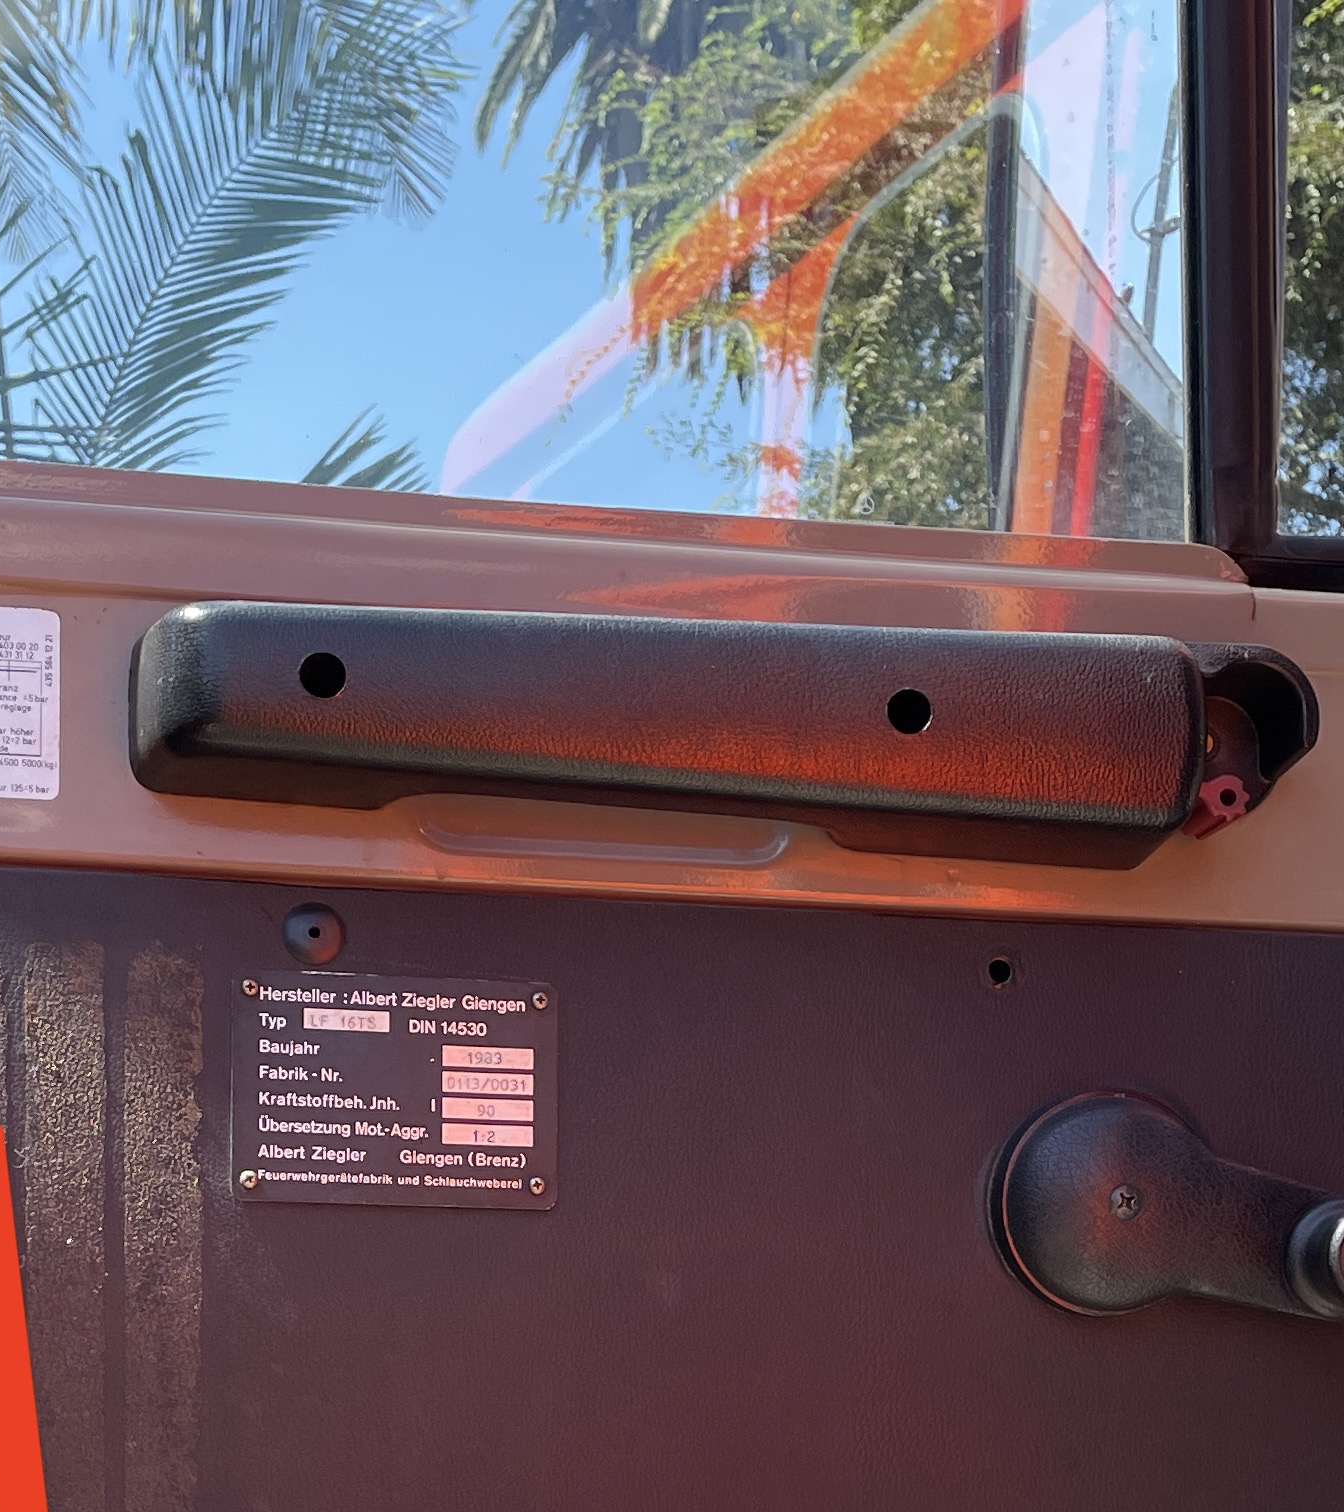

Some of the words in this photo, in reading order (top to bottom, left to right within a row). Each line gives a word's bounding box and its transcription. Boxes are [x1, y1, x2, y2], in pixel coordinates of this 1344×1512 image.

[0, 757, 19, 766] 4500
[259, 986, 337, 1002] Hersteller
[401, 992, 456, 1011] Ziegler
[461, 994, 526, 1014] Giengen
[259, 1012, 287, 1030] Typ
[310, 1014, 328, 1027] LF
[341, 1016, 376, 1029] 16TS
[408, 1019, 436, 1034] DIN
[441, 1021, 487, 1037] 14530
[259, 1039, 320, 1056] Baujahr
[467, 1051, 502, 1065] 1983
[259, 1091, 366, 1109] Kraftstoffbeh.
[369, 1096, 400, 1110] Jnh.
[478, 1105, 495, 1117] 90
[259, 1114, 351, 1137] Übersetzung
[473, 1130, 495, 1143] 1:2
[258, 1144, 305, 1159] Albert
[311, 1146, 366, 1163] Ziegler
[468, 1151, 526, 1168] (Brenz)
[258, 1169, 393, 1185] Feuerwehrgerätefabrik
[398, 1176, 419, 1185] und
[424, 1175, 522, 1189] Schlauchweberei
